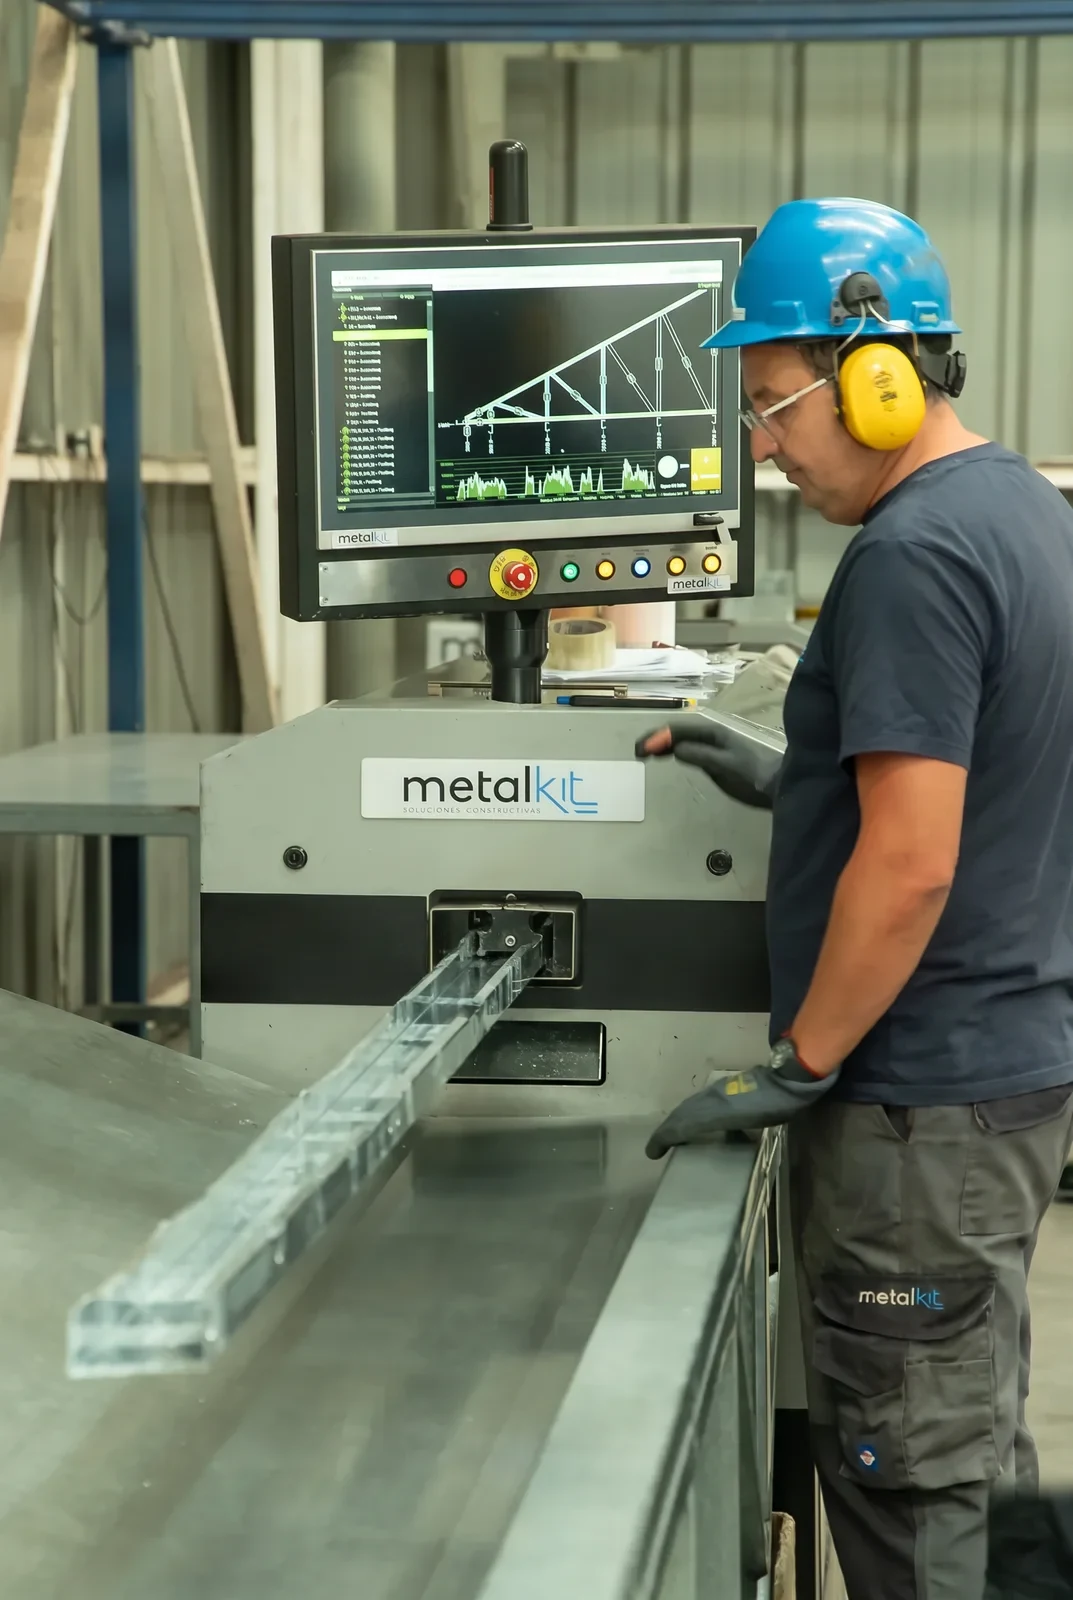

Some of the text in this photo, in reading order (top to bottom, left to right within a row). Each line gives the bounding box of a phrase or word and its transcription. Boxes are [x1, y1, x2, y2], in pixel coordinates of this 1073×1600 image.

[338, 531, 392, 544] metalkit
[673, 576, 724, 589] metalkit
[403, 765, 598, 814] metalkit
[402, 807, 541, 815] SOLUCIONES CONSTRUCTIVAS
[858, 1287, 944, 1310] metalkit
